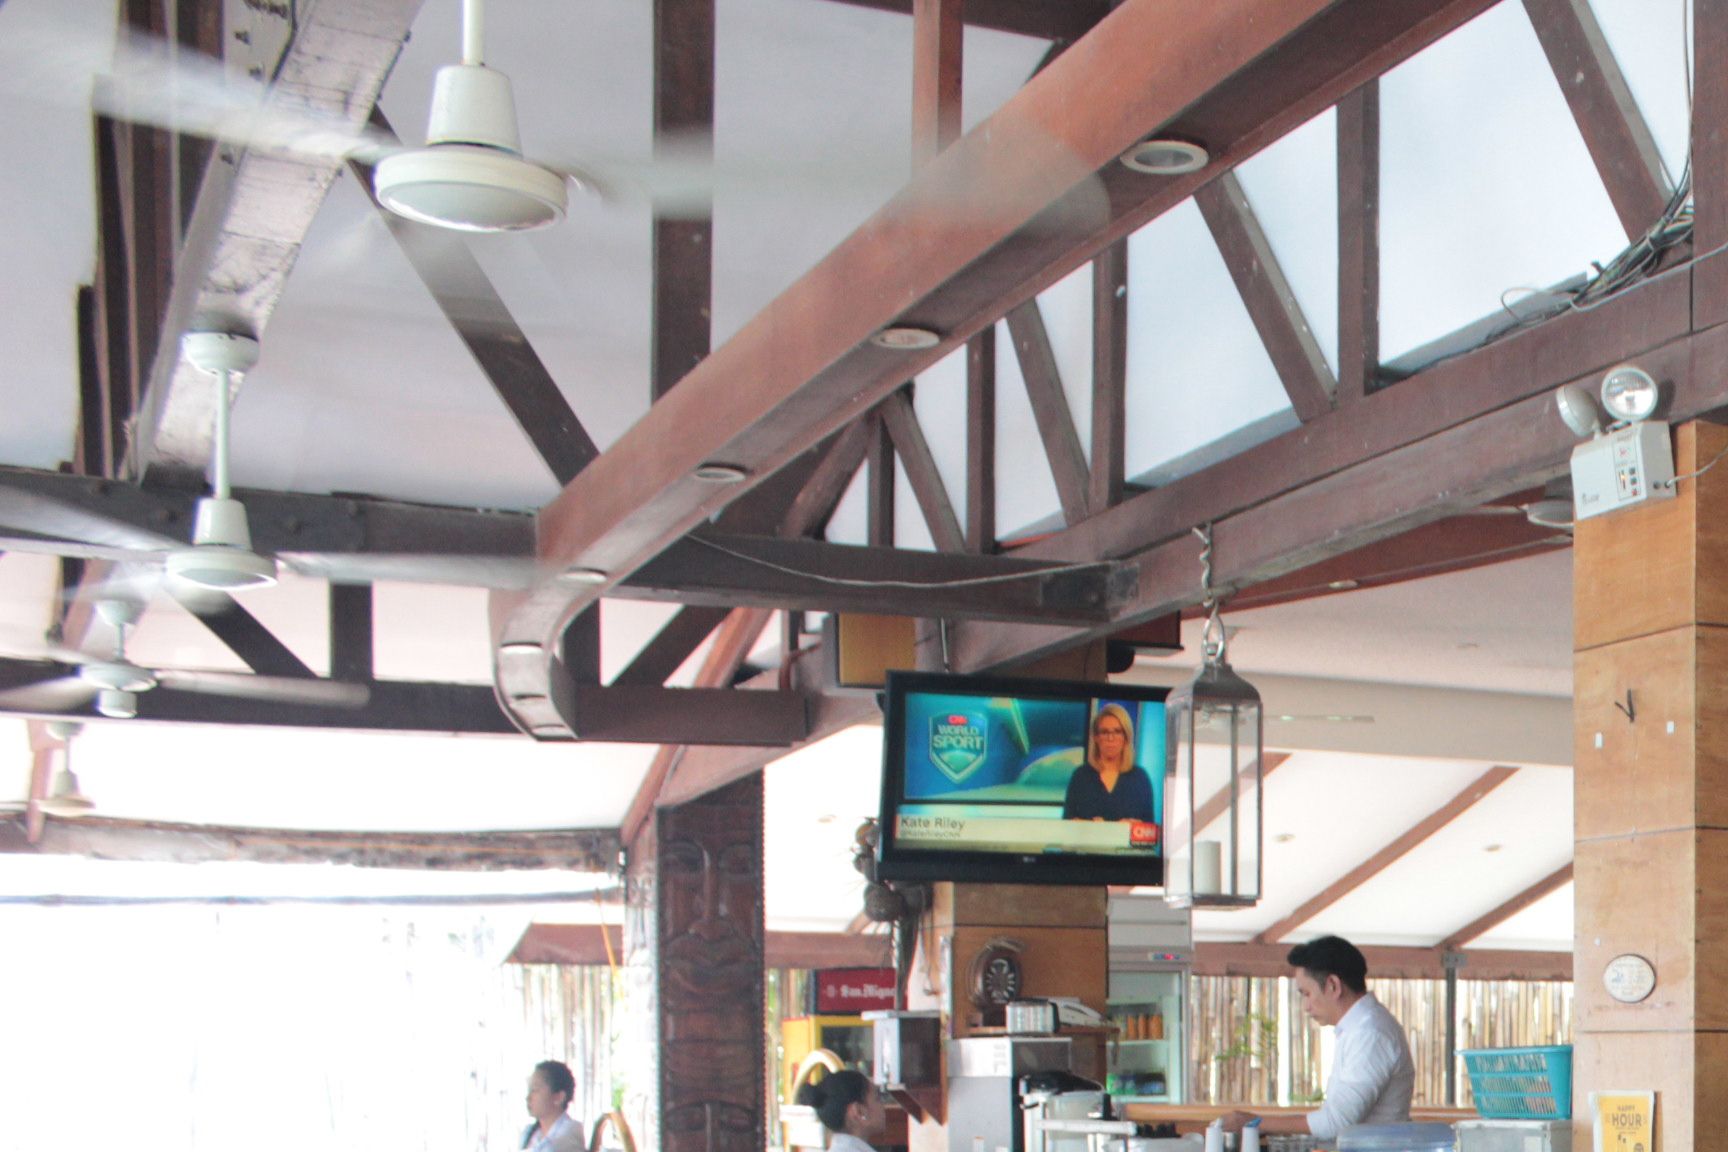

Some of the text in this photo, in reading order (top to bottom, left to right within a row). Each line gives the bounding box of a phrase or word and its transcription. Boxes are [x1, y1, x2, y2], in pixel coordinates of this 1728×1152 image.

[937, 724, 980, 736] WORLD
[932, 735, 985, 750] SPORT
[901, 817, 966, 832] Kate Riley
[1611, 1112, 1643, 1127] HOUR
